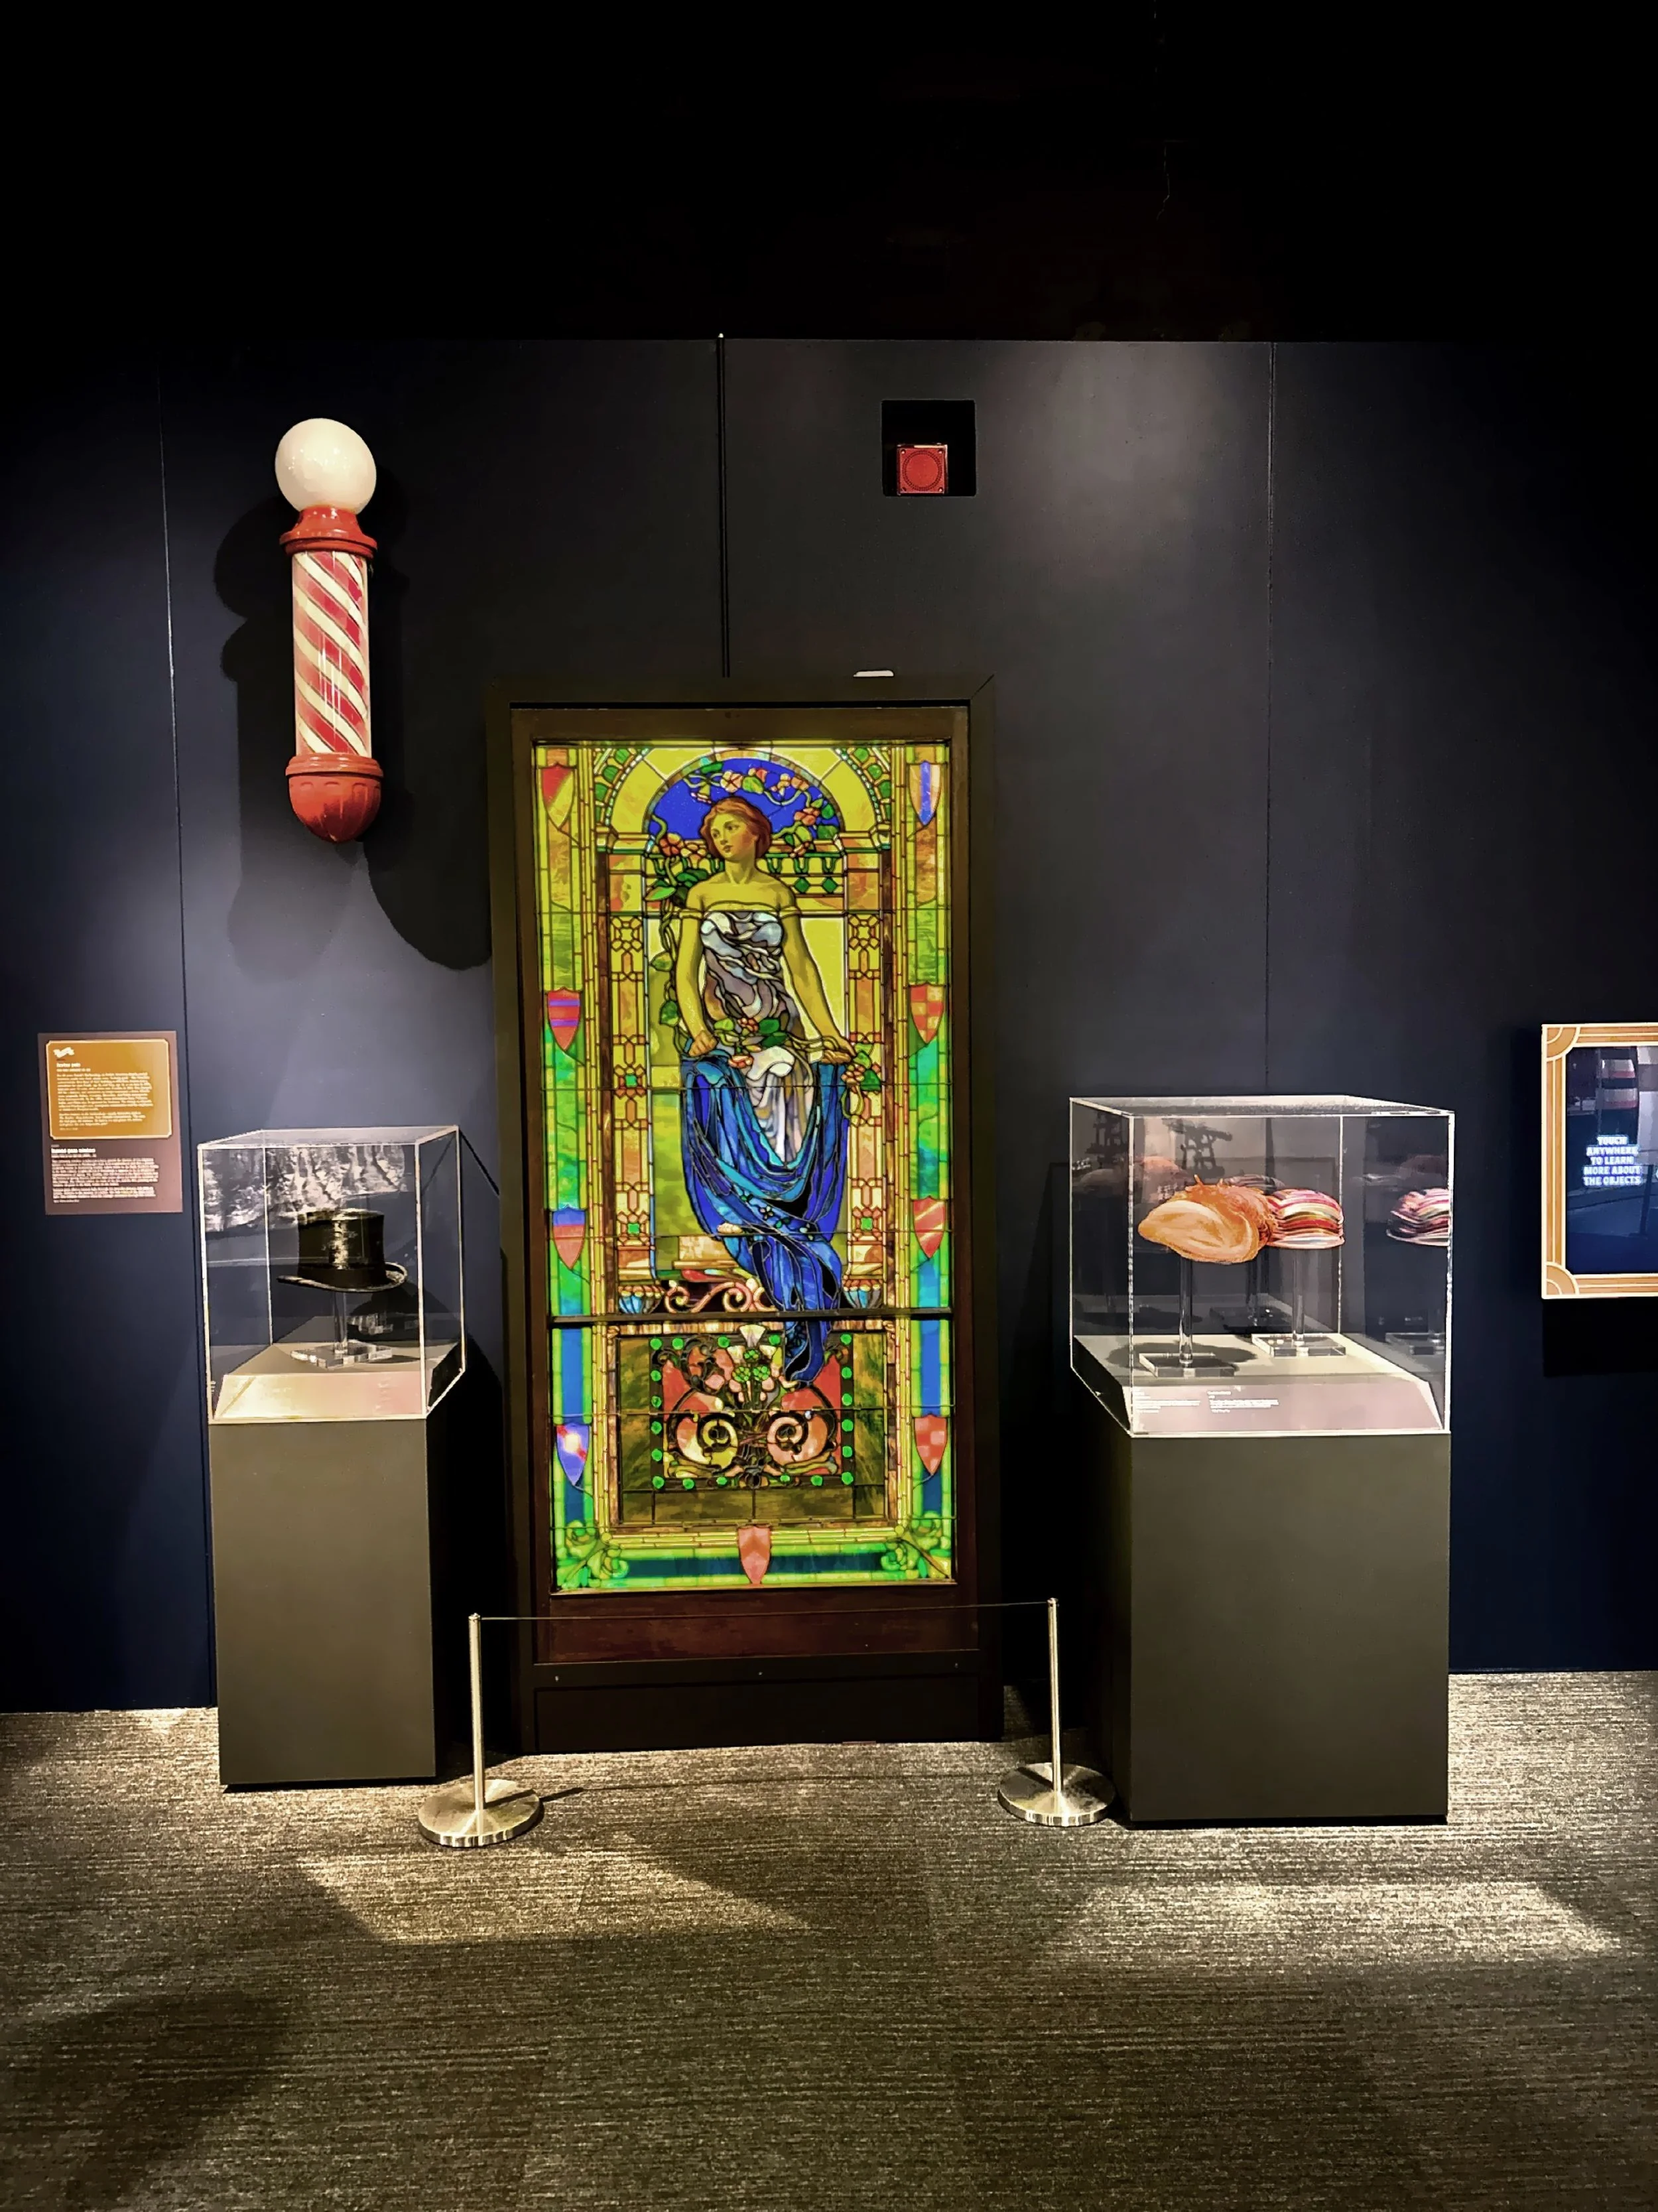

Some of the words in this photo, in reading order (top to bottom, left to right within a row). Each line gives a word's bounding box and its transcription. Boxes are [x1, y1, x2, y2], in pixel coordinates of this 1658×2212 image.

[1597, 1136, 1627, 1145] TOUCH
[1586, 1146, 1638, 1155] ANYWHERE
[1590, 1156, 1603, 1165] TO
[1604, 1156, 1633, 1165] LEARN
[1584, 1166, 1610, 1175] MORE
[1612, 1166, 1640, 1175] ABOUT
[1584, 1177, 1602, 1186] THE
[1603, 1176, 1641, 1185] OBJECTS
